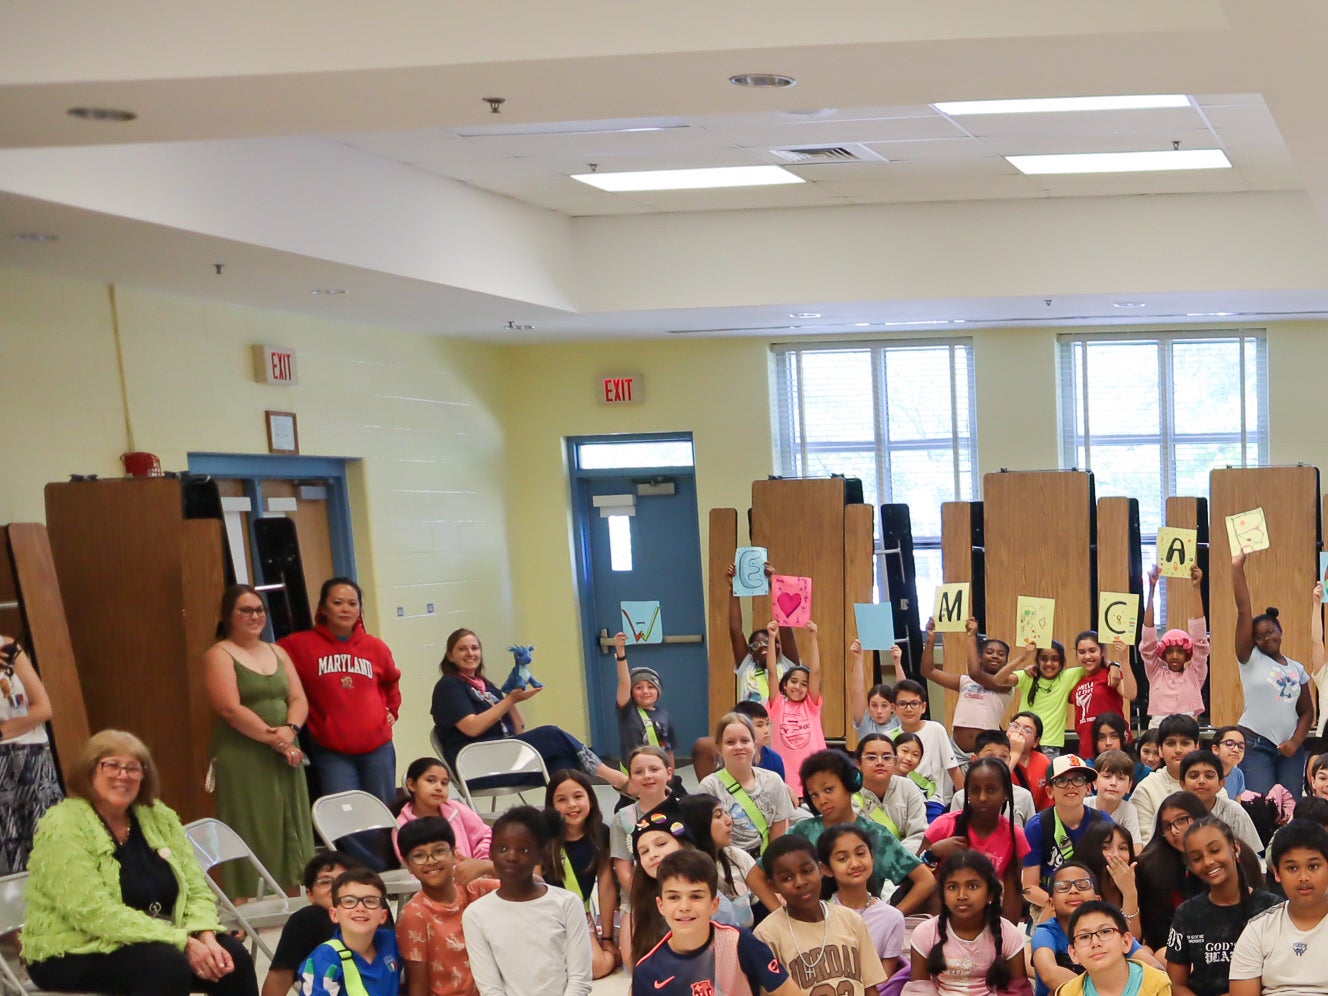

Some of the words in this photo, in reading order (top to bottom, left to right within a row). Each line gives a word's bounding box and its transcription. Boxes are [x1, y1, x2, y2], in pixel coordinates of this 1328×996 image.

[270, 351, 292, 381] EXIT
[604, 378, 633, 403] EXIT
[1165, 537, 1186, 566] A
[738, 550, 764, 589] E
[938, 589, 963, 623] M
[1104, 600, 1128, 635] C
[622, 606, 660, 643] W
[318, 654, 374, 680] MARYLAND
